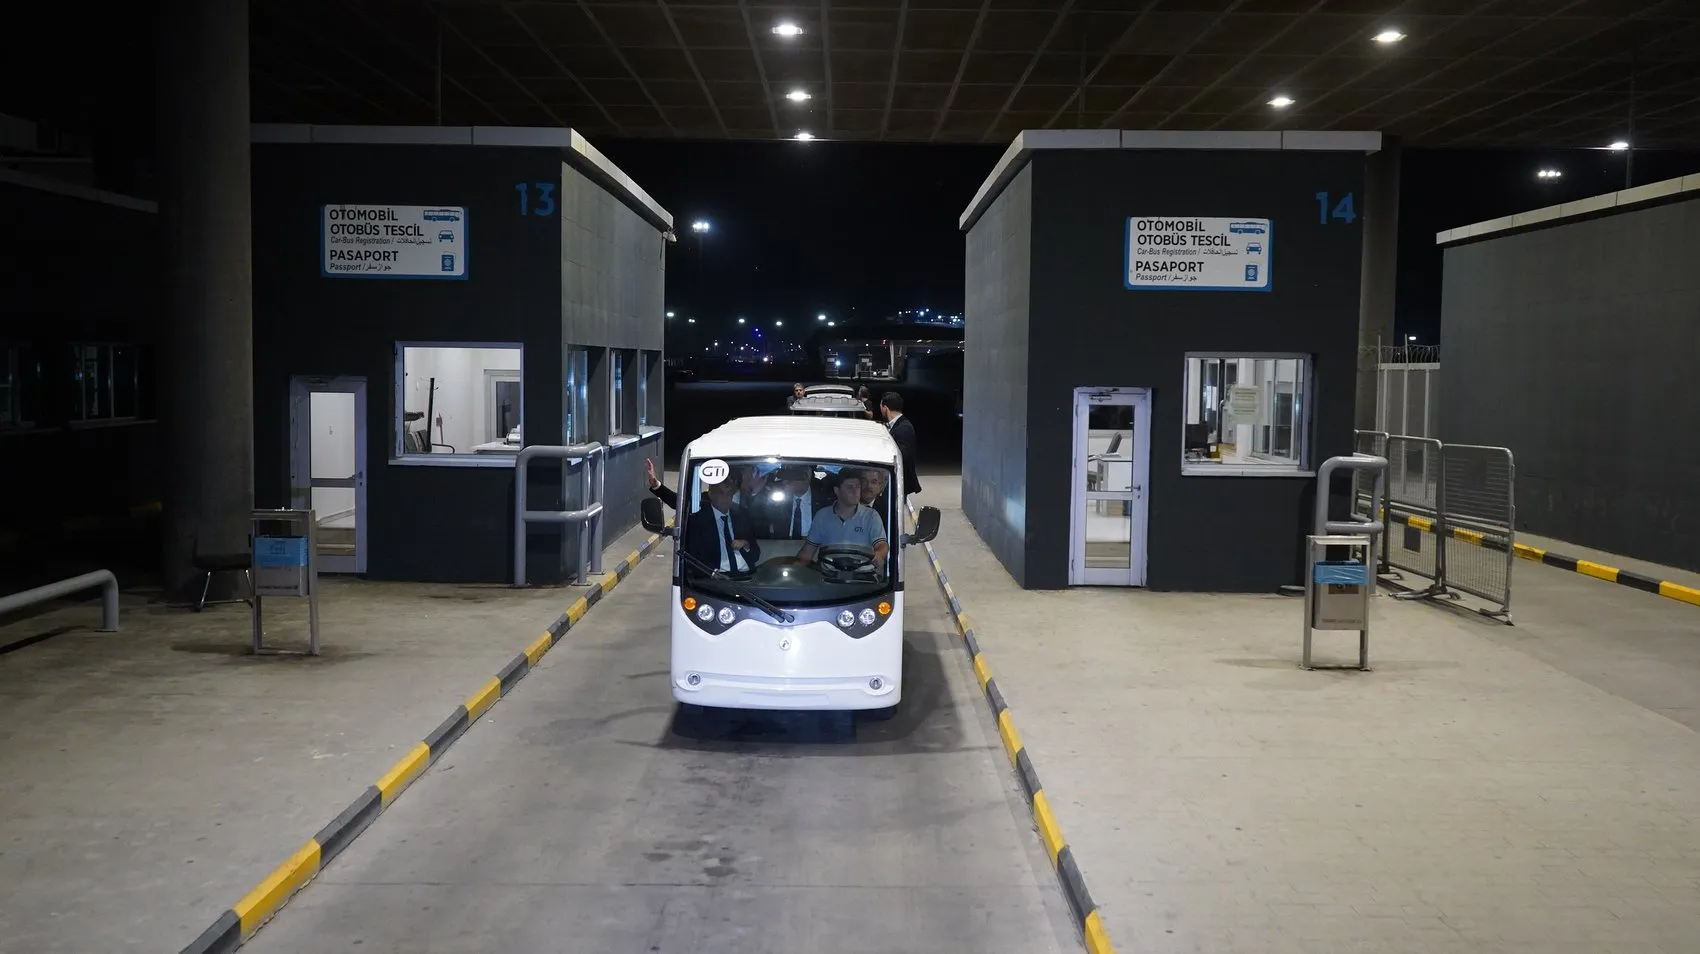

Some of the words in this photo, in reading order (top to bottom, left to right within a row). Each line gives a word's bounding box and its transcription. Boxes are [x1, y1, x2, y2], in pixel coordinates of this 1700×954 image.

[515, 183, 555, 217] 13
[329, 207, 399, 221] OTOMOBİL
[1315, 191, 1357, 225] 14
[330, 222, 380, 236] OTOBÜS
[383, 223, 425, 237] TESCİL
[1137, 218, 1206, 232] OTOMOBİL
[331, 236, 354, 244] Car-Bus
[356, 236, 391, 246] Registration
[1137, 232, 1187, 246] OTOBÜS
[1190, 233, 1231, 247] TESCİL
[329, 249, 399, 262] PASAPORT
[1137, 247, 1160, 255] Car-Bus
[1162, 247, 1197, 257] Registration
[329, 262, 362, 272] Passport
[1135, 260, 1205, 273] PASAPORT
[1135, 273, 1167, 283] Passport
[702, 465, 725, 477] GTI
